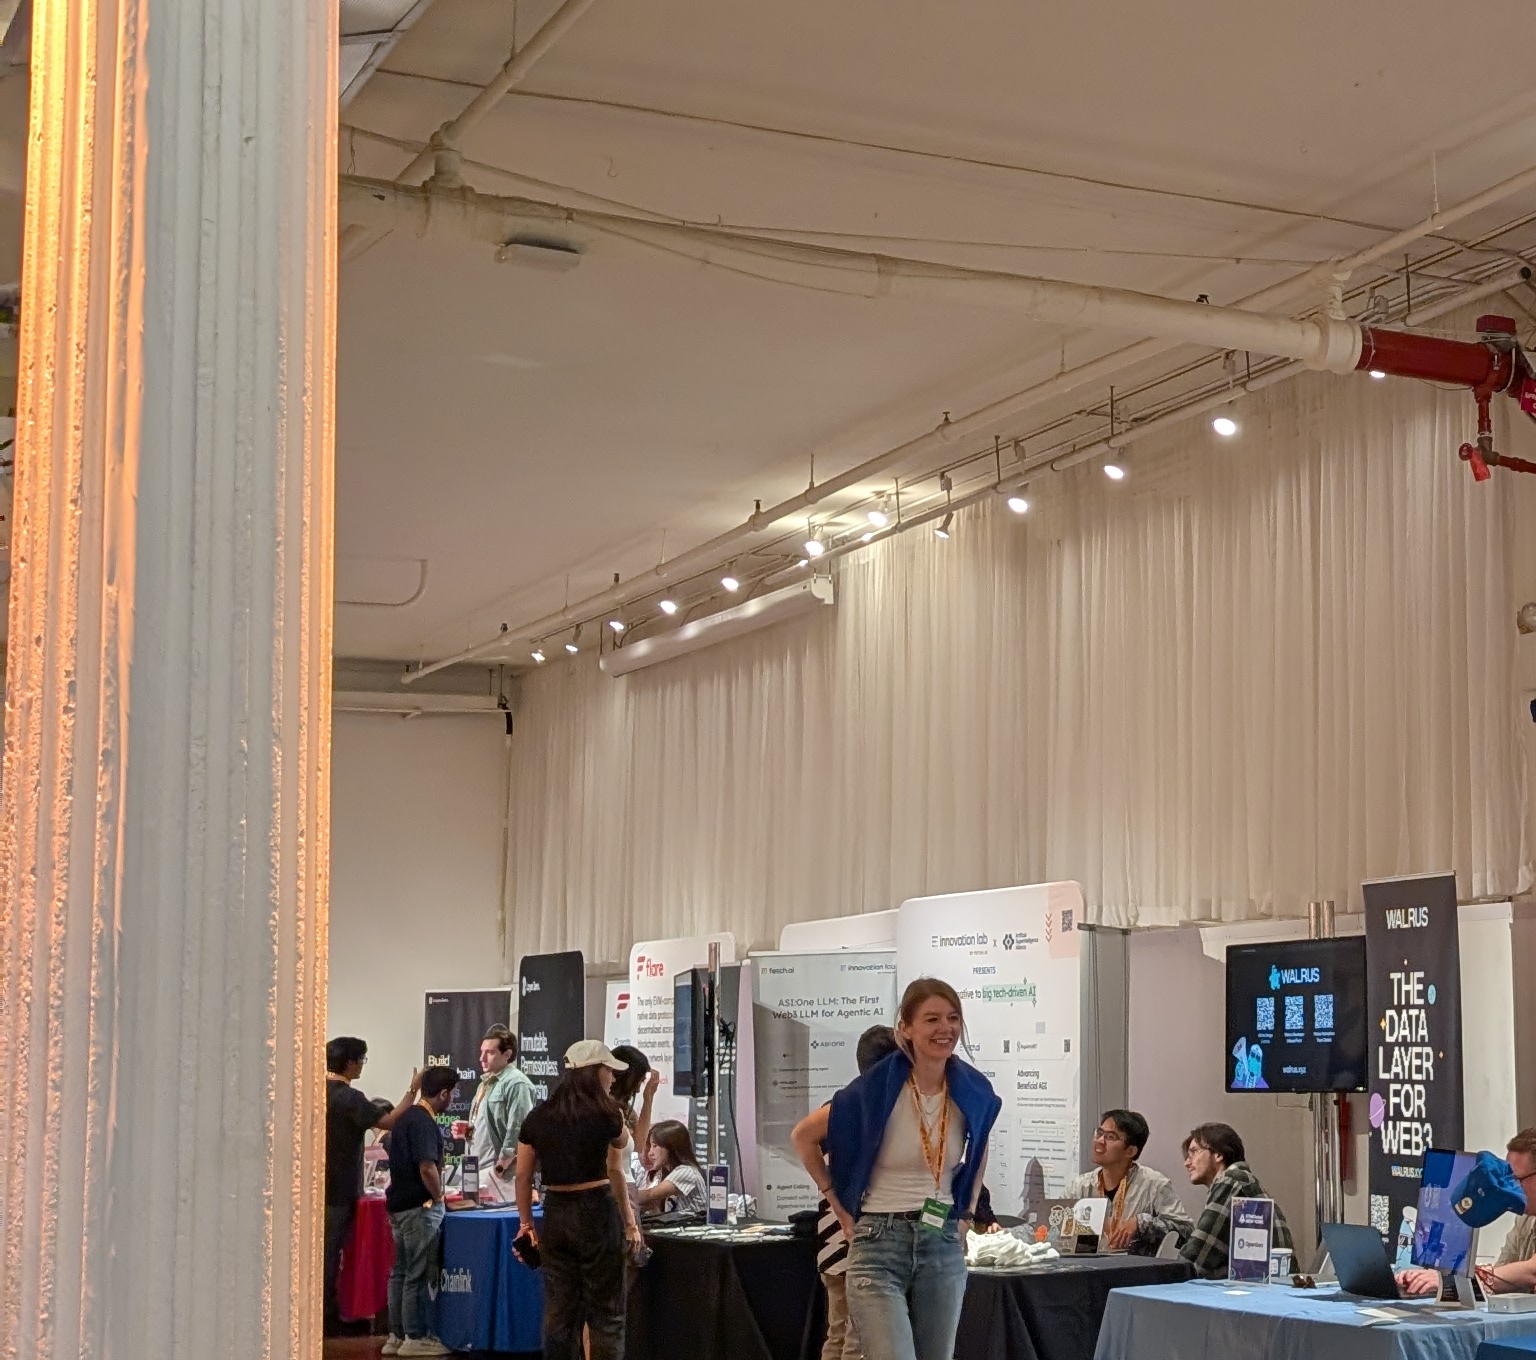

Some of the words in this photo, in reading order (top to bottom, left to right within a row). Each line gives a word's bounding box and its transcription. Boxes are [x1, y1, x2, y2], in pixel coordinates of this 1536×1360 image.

[1385, 906, 1429, 929] WALRUS
[940, 934, 976, 947] innovation
[977, 932, 989, 945] lab
[646, 957, 664, 977] flare
[972, 966, 996, 974] PRESENTS
[1281, 967, 1320, 984] WALRUS
[975, 988, 982, 998] to
[982, 987, 992, 1001] big
[993, 986, 1028, 998] tech-driven
[1028, 985, 1036, 996] AI
[1390, 971, 1425, 1005] THE
[817, 997, 839, 1006] LLM:
[841, 996, 857, 1005] The
[772, 1010, 798, 1019] Web3
[800, 1009, 818, 1018] LLM
[821, 1009, 835, 1017] for
[837, 1008, 871, 1019] Agentic
[873, 1007, 884, 1016] AI
[1385, 1009, 1429, 1042] DATA
[428, 1055, 450, 1067] Build
[1379, 1046, 1434, 1080] LAYER
[1017, 1069, 1039, 1079] Advancing
[1389, 1083, 1426, 1118] FOR
[1381, 1120, 1433, 1156] WEB3
[1391, 1165, 1423, 1178] WALRUS.XY
[441, 1267, 472, 1292] Chainlink
